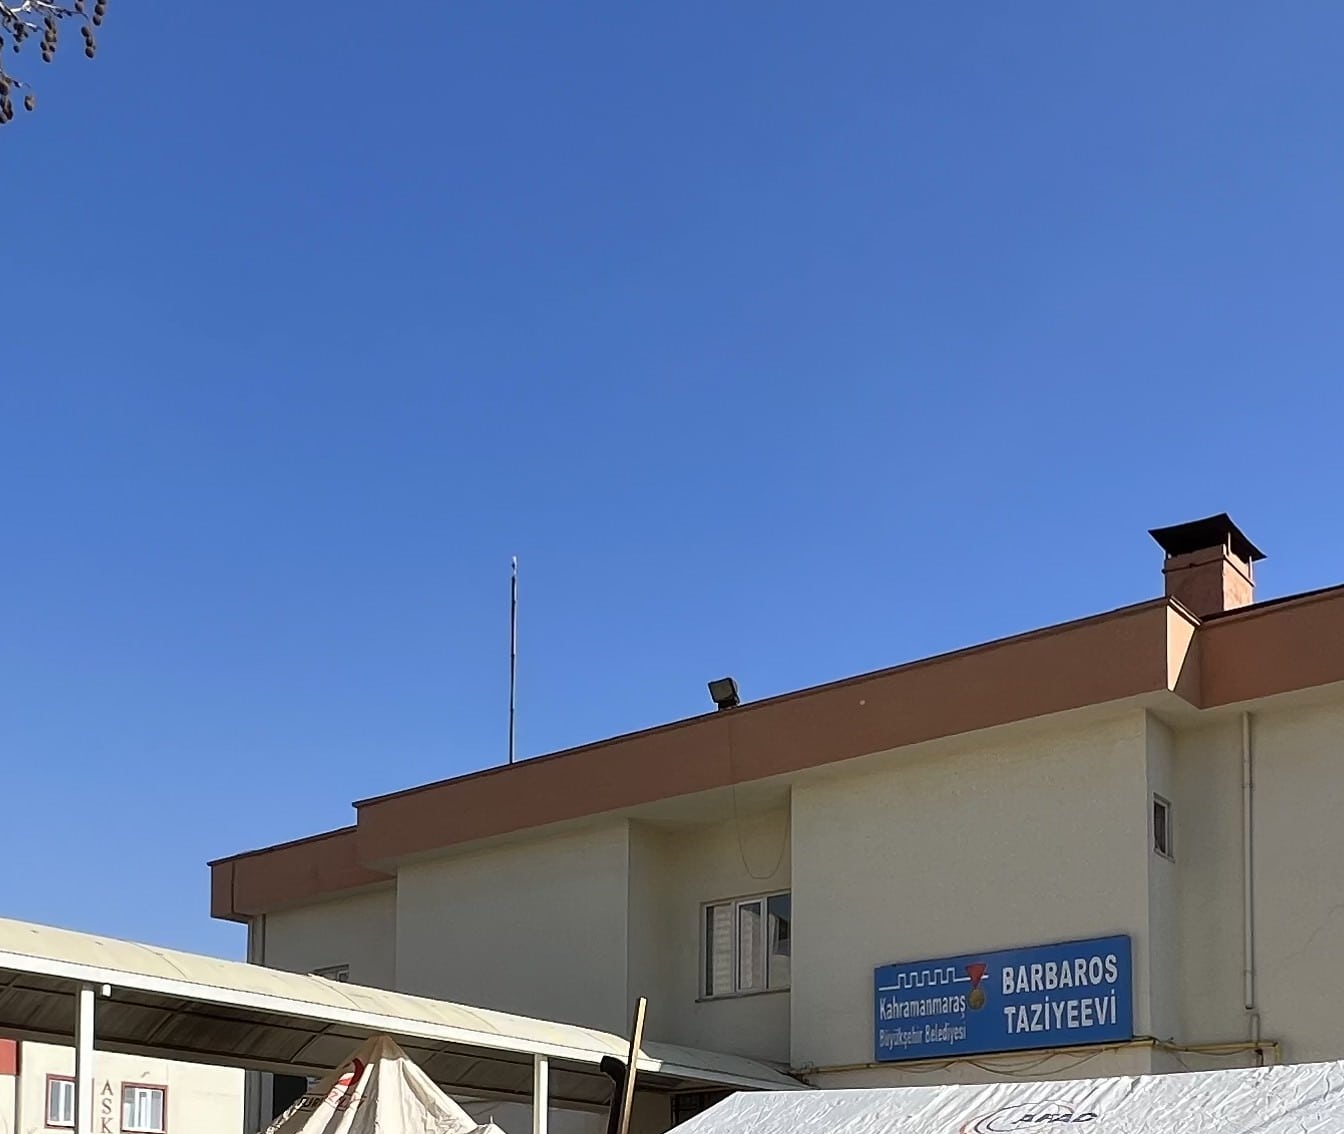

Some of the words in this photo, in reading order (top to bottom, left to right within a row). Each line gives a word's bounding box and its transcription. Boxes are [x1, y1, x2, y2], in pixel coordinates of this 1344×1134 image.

[1001, 954, 1119, 995] BARBAROS
[878, 994, 967, 1020] Kahramanmaraş
[1003, 988, 1118, 1035] TAZİYEEVİ
